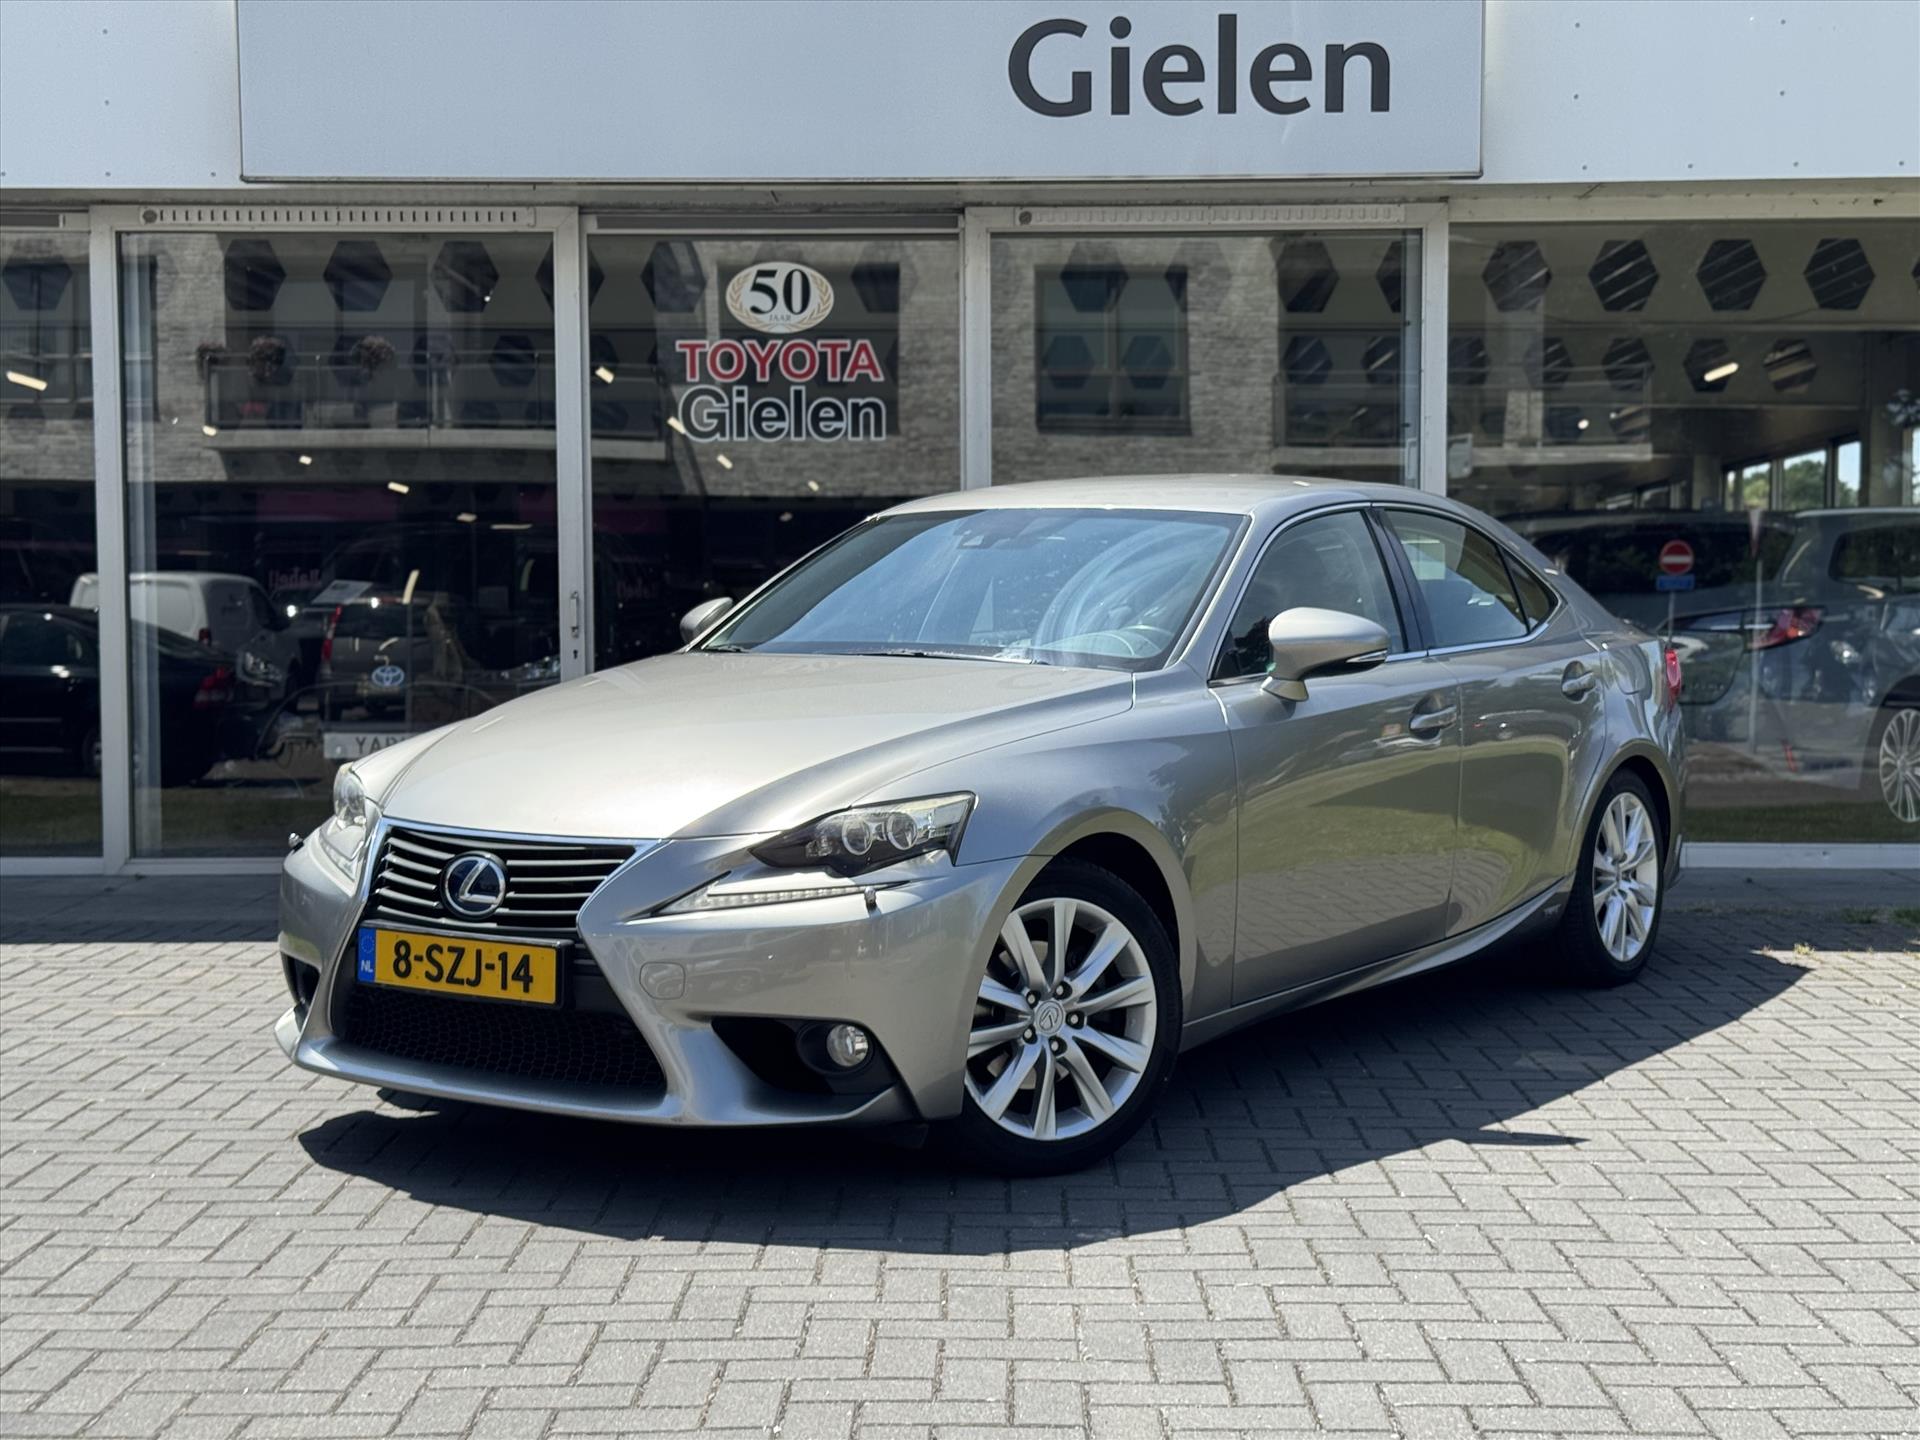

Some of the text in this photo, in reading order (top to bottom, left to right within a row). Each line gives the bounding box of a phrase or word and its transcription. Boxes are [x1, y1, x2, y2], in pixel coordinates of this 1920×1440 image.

[1008, 13, 1391, 118] Gielen
[749, 268, 812, 315] 50
[768, 313, 792, 322] JAAR
[675, 339, 885, 383] TOYOTA
[678, 384, 887, 443] Gielen
[360, 959, 374, 974] NL
[392, 939, 534, 994] 8-SZJ-14
